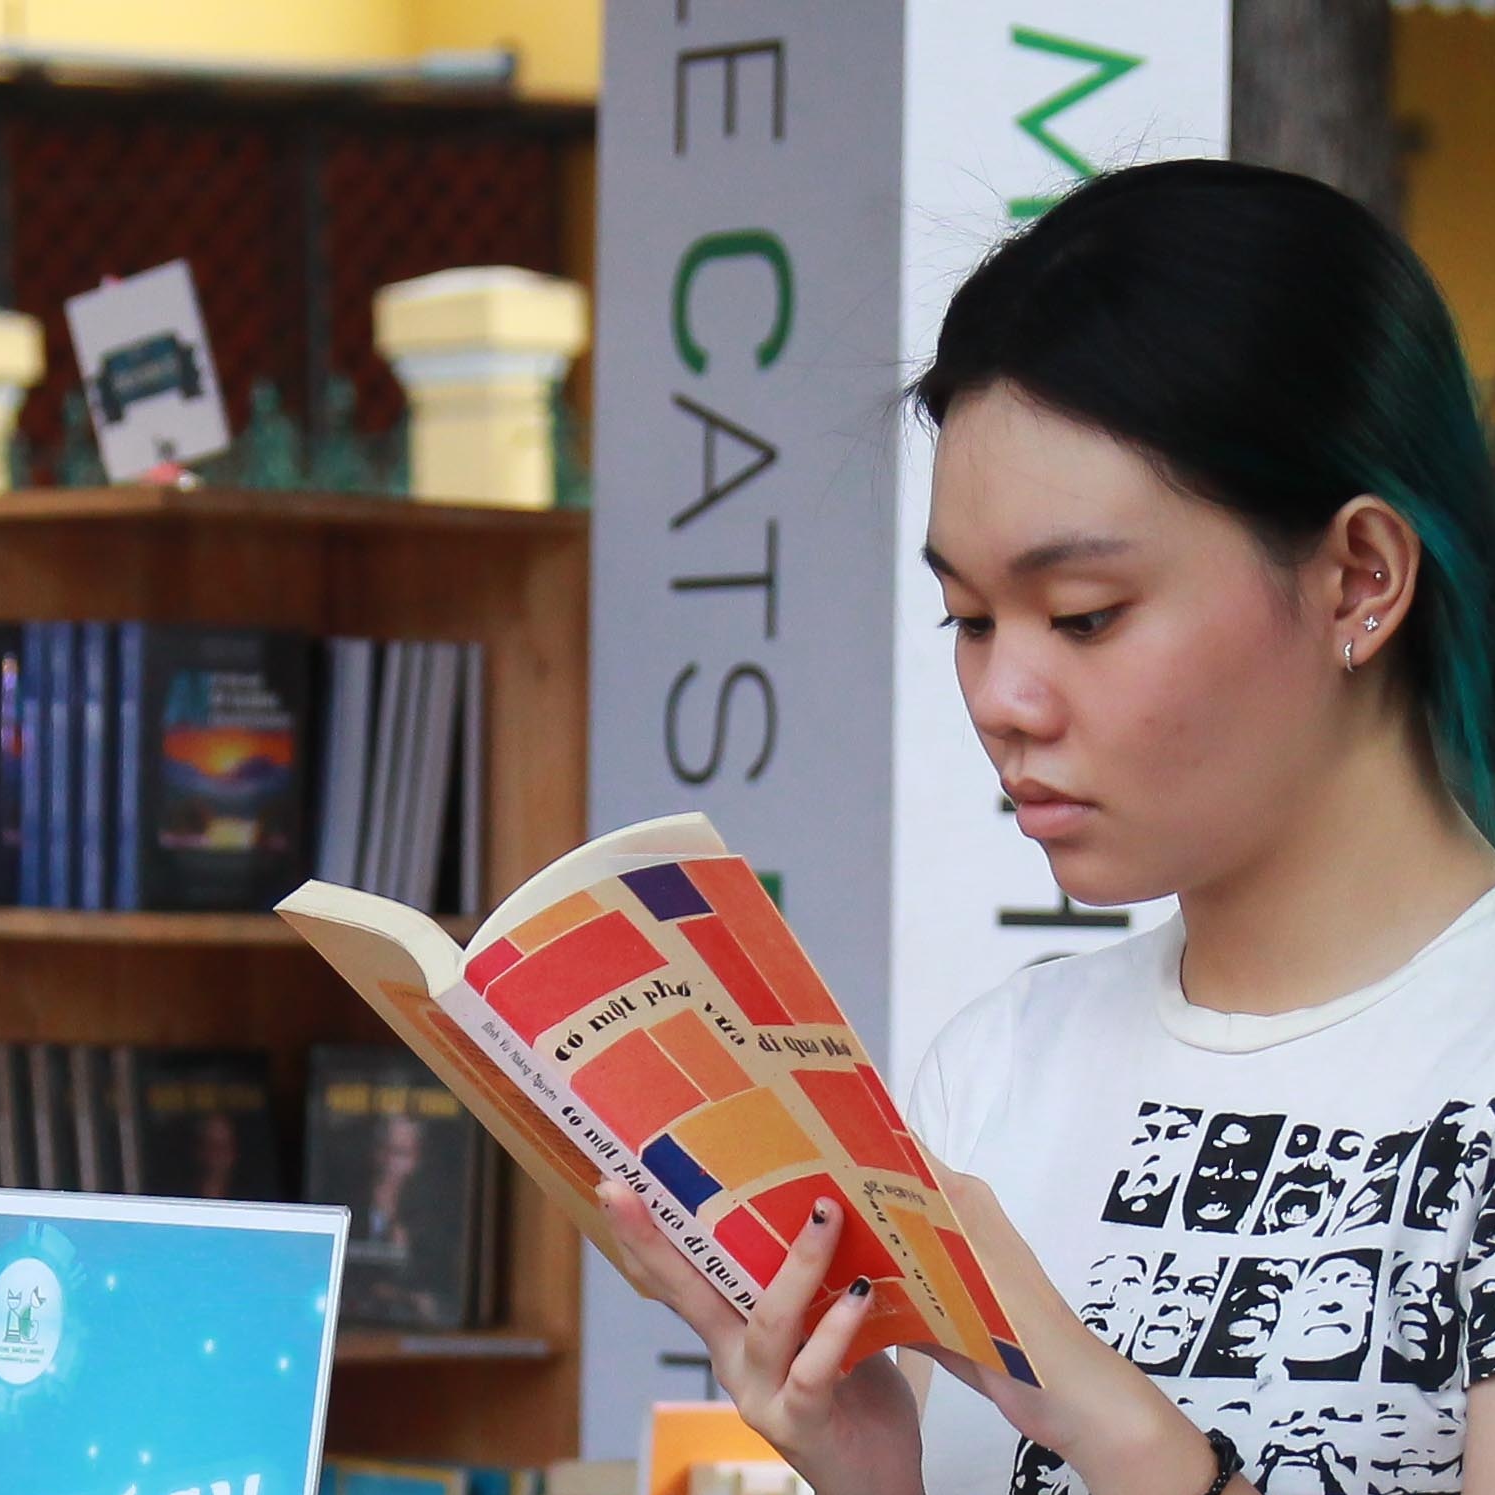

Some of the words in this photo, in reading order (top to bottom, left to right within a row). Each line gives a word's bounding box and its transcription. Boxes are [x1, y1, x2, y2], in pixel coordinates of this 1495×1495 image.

[664, 226, 796, 786] CATS
[555, 1030, 584, 1062] có
[587, 993, 638, 1034] một
[757, 1032, 780, 1053] đi
[786, 1036, 820, 1058] qua
[560, 1104, 583, 1127] có
[584, 1128, 618, 1162] một
[683, 1235, 707, 1257] đi
[706, 1255, 739, 1289] qua
